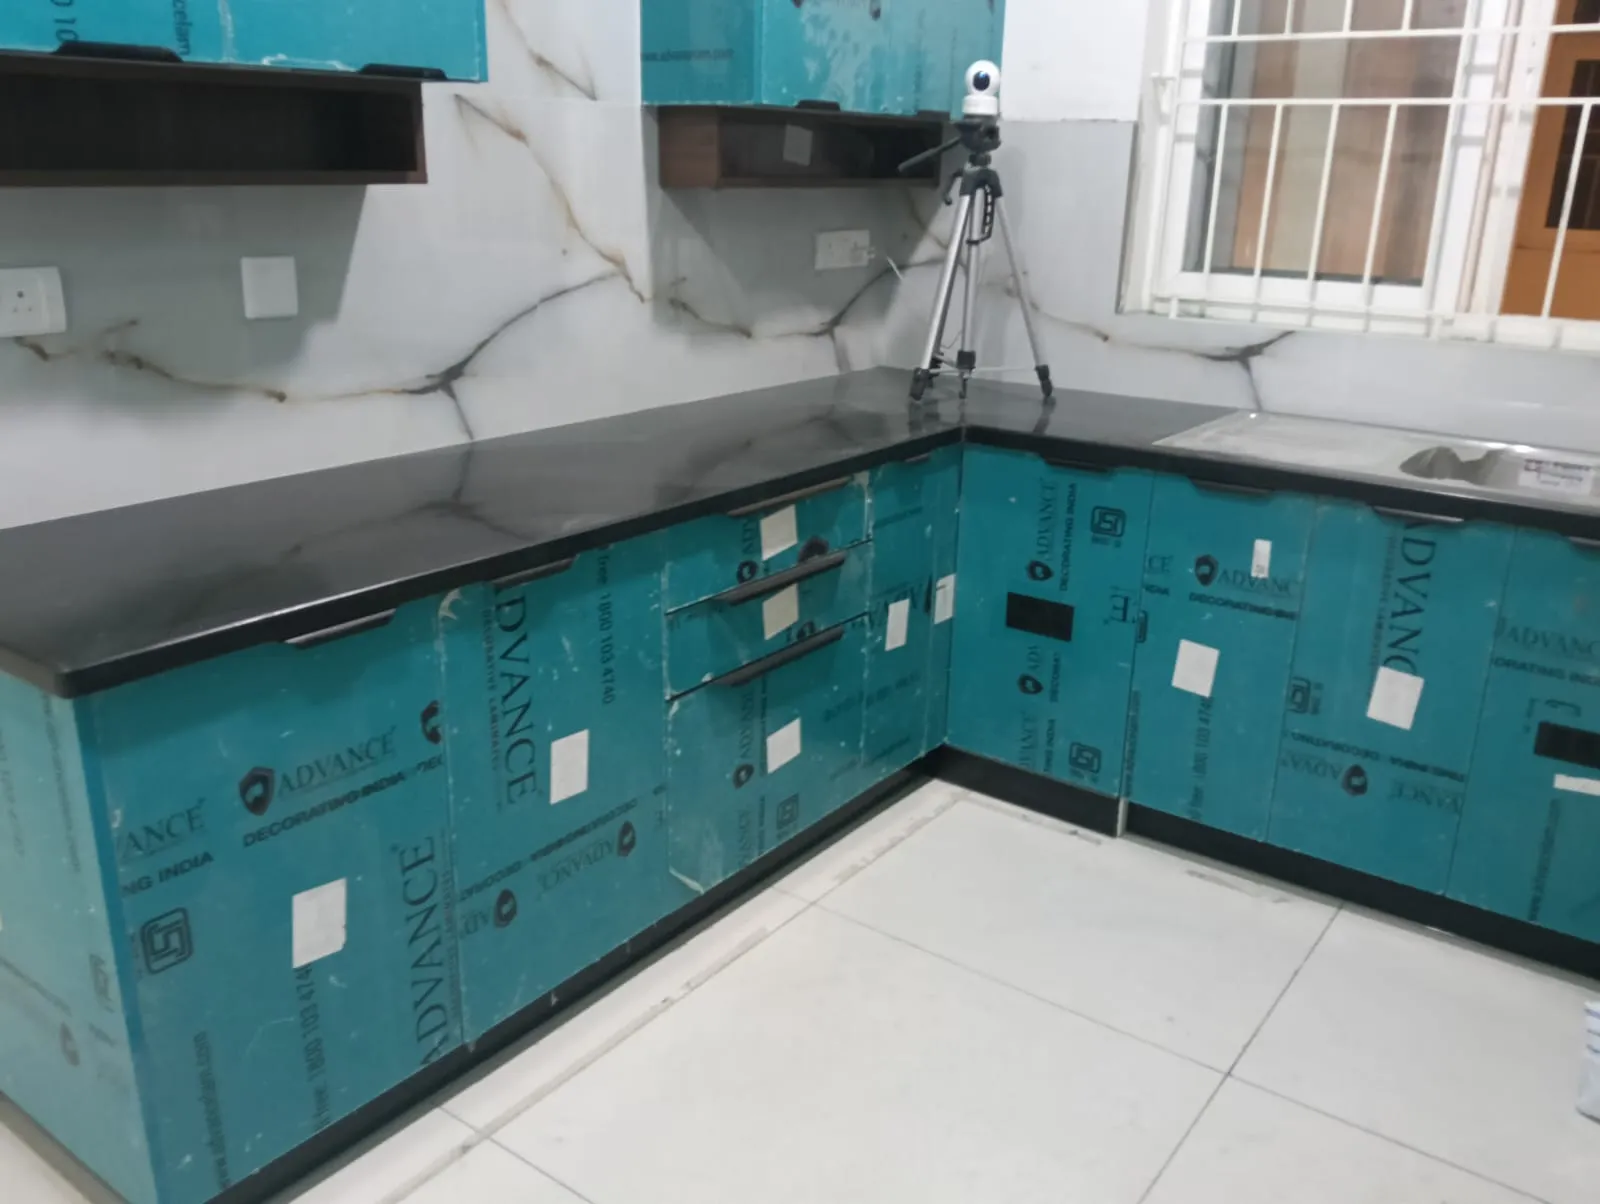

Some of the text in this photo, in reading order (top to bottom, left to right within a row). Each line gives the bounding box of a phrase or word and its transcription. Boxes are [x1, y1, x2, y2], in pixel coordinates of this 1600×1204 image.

[1037, 482, 1058, 561] ADVANCE
[1060, 517, 1074, 591] DECORATING
[1383, 522, 1437, 676] DVANC
[603, 634, 616, 662] 103
[494, 586, 538, 804] DVANCE
[278, 731, 398, 797] ADVANCE
[243, 790, 359, 848] DECORATING
[159, 850, 214, 883] INDIA
